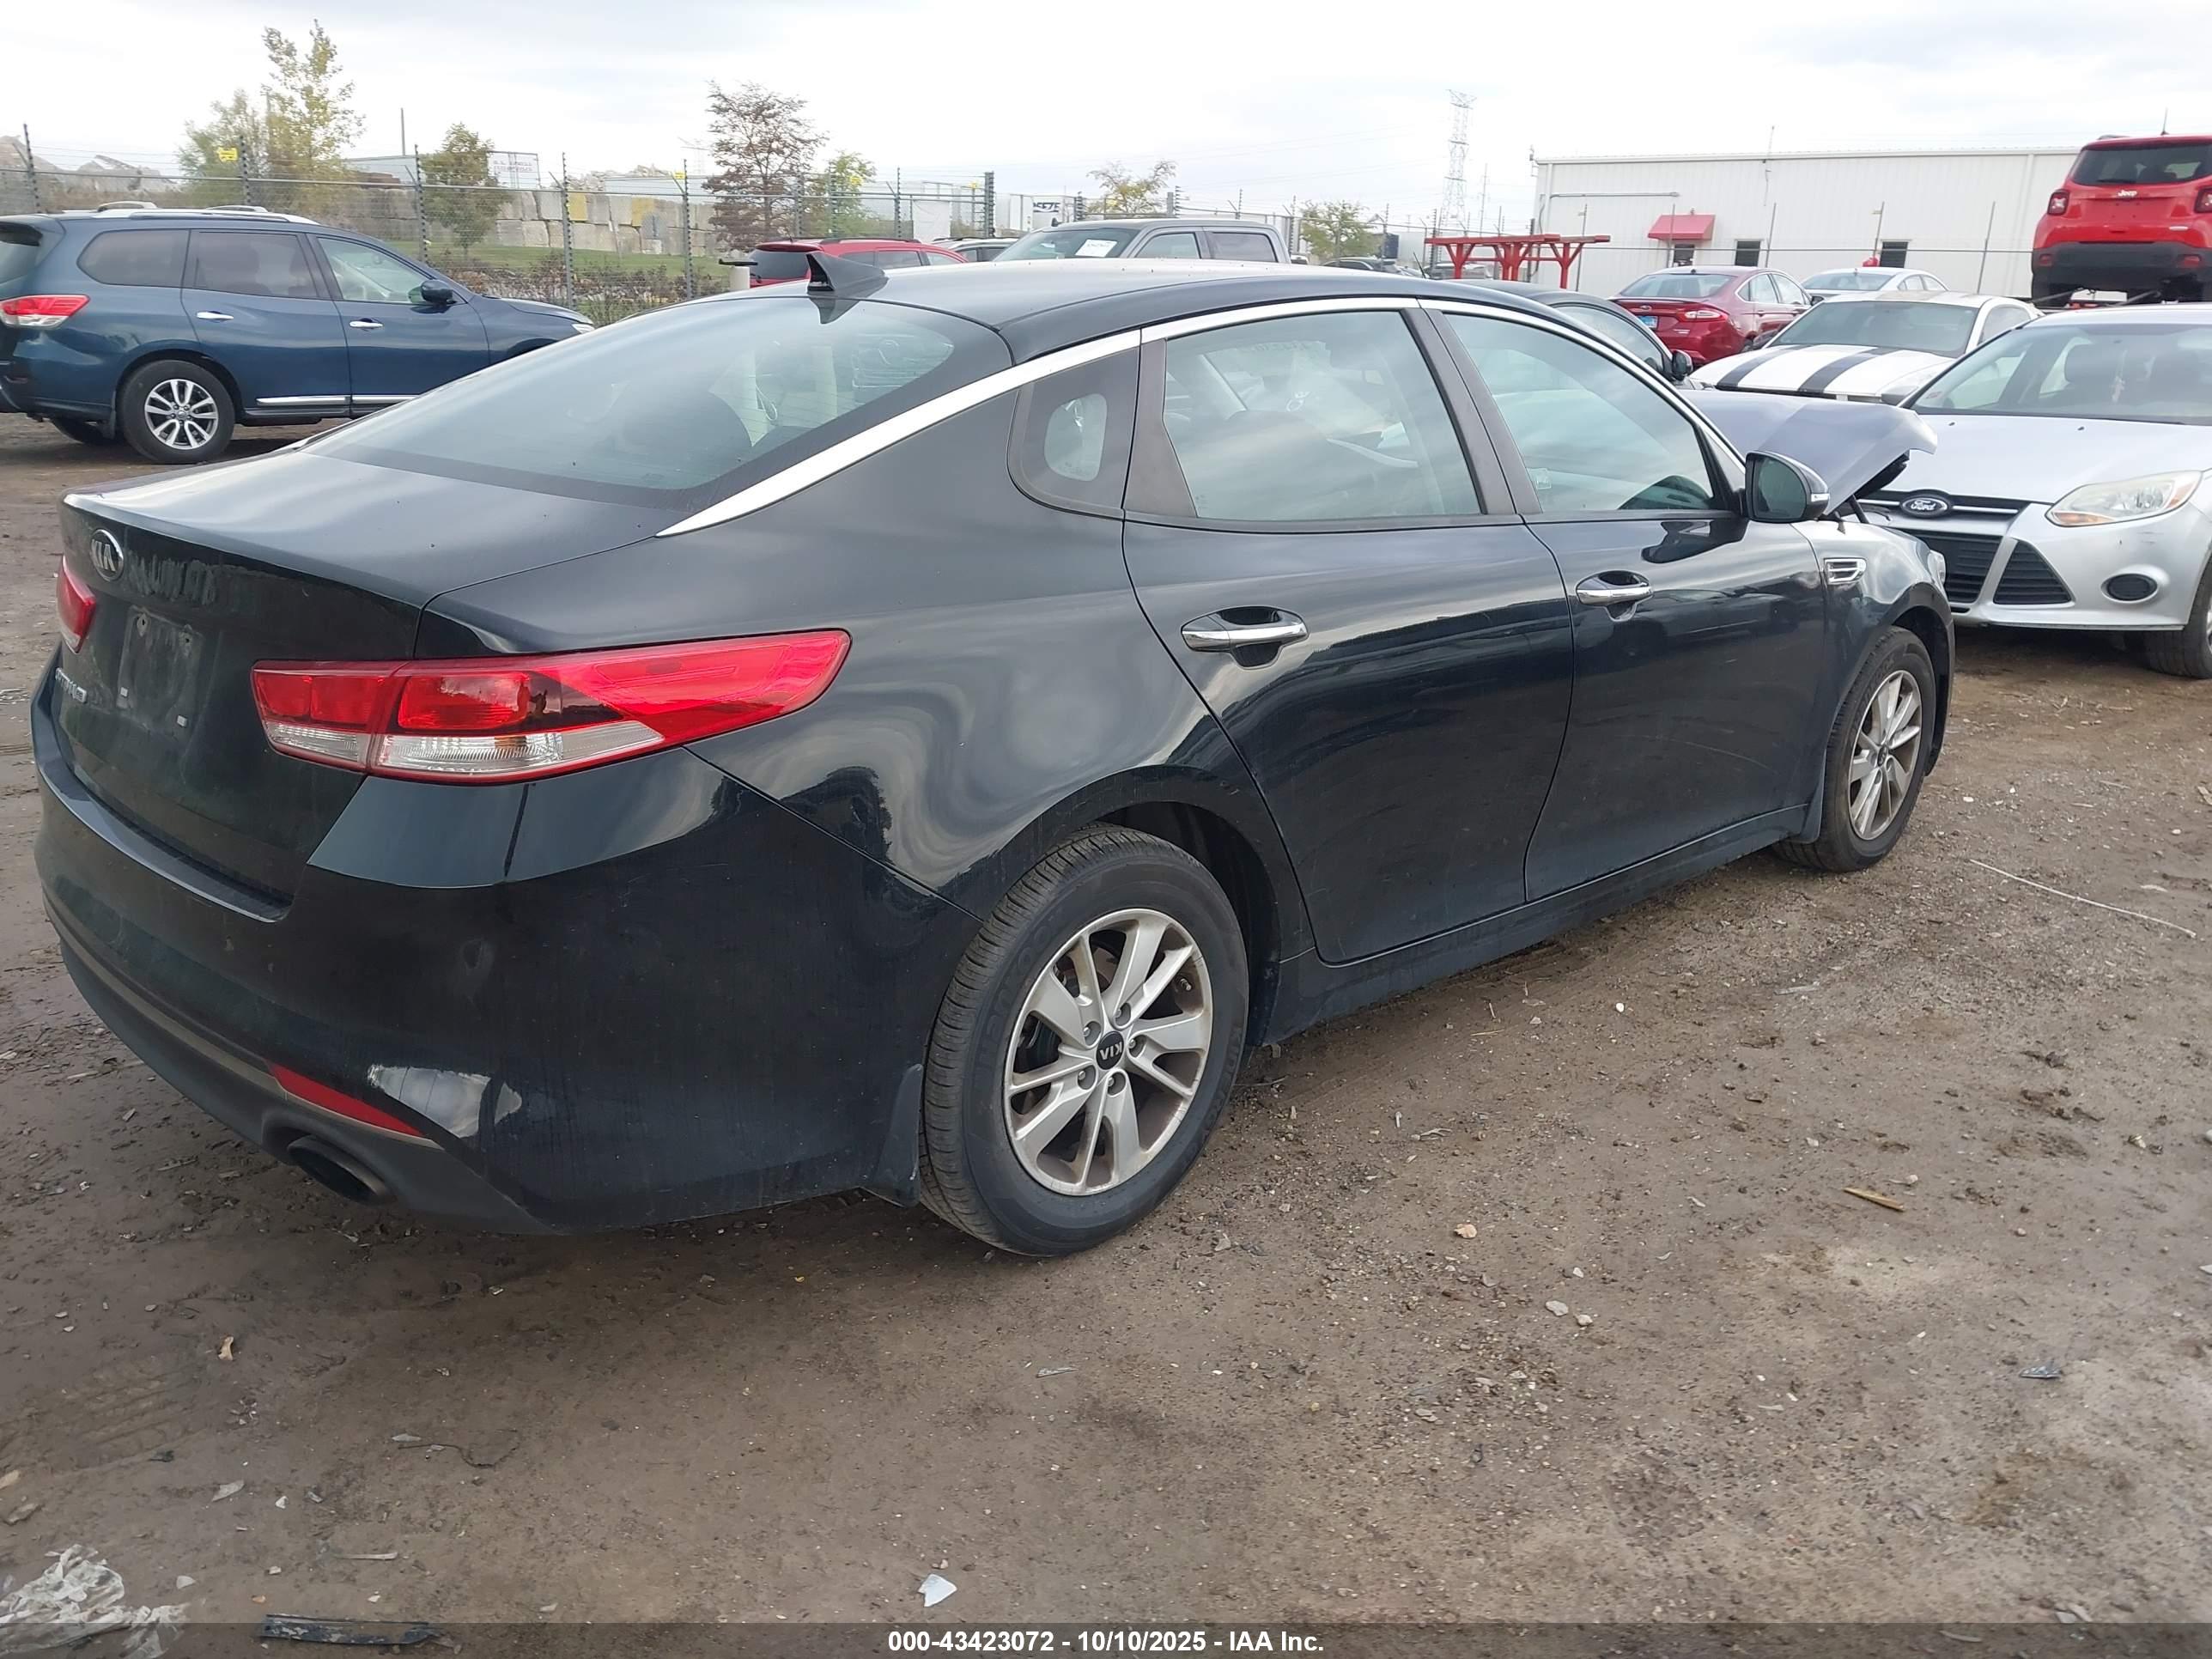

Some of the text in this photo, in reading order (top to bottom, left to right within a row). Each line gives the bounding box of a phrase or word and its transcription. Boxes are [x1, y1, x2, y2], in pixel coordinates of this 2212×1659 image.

[2117, 189, 2138, 198] Jeep
[1910, 499, 1936, 512] Ford
[91, 538, 116, 573] KIA
[1099, 1041, 1123, 1060] KIA
